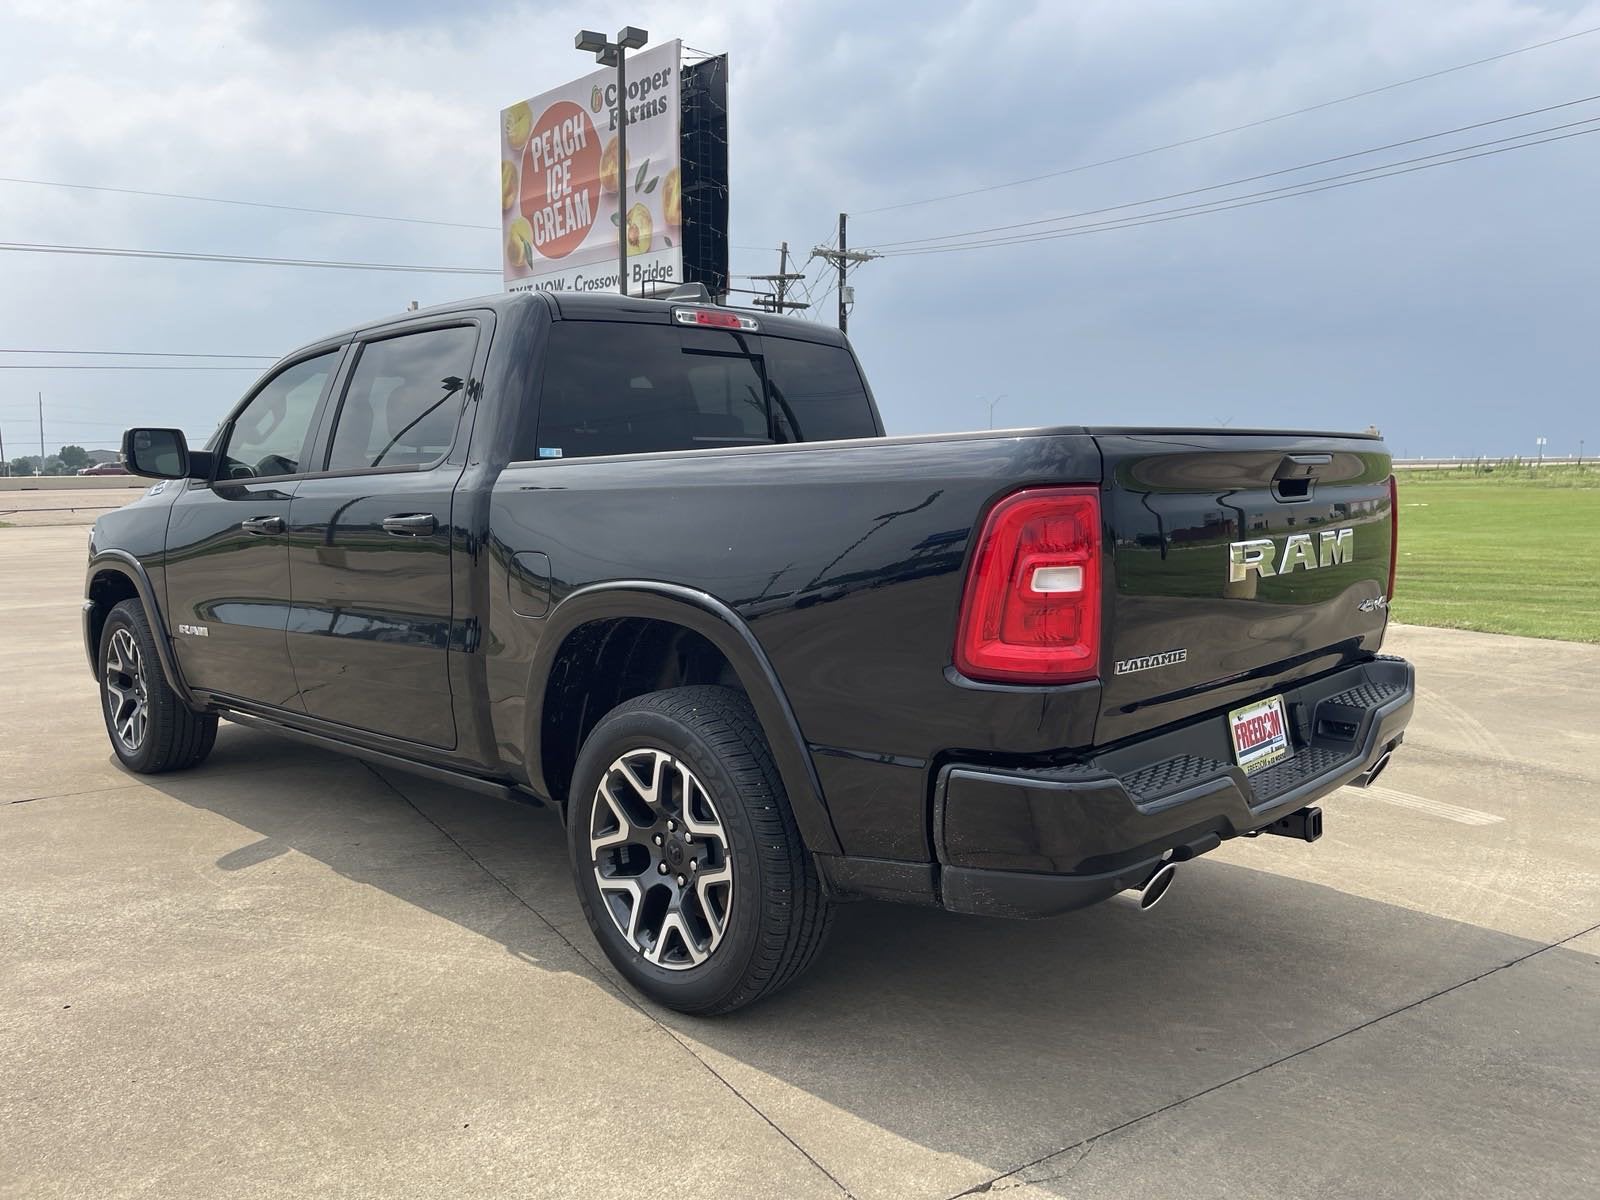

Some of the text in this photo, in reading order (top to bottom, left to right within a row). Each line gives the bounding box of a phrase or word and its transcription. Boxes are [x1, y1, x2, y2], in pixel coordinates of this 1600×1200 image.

[605, 67, 671, 107] Coper
[531, 112, 587, 174] PEACH
[546, 158, 572, 204] ICE
[532, 188, 592, 247] CREAM
[574, 273, 629, 292] Crossov
[633, 260, 673, 283] Bridge
[1229, 528, 1354, 583] RAM
[179, 624, 208, 637] RAM
[1114, 648, 1187, 676] LARAMIE
[1234, 709, 1282, 752] FREEDOM
